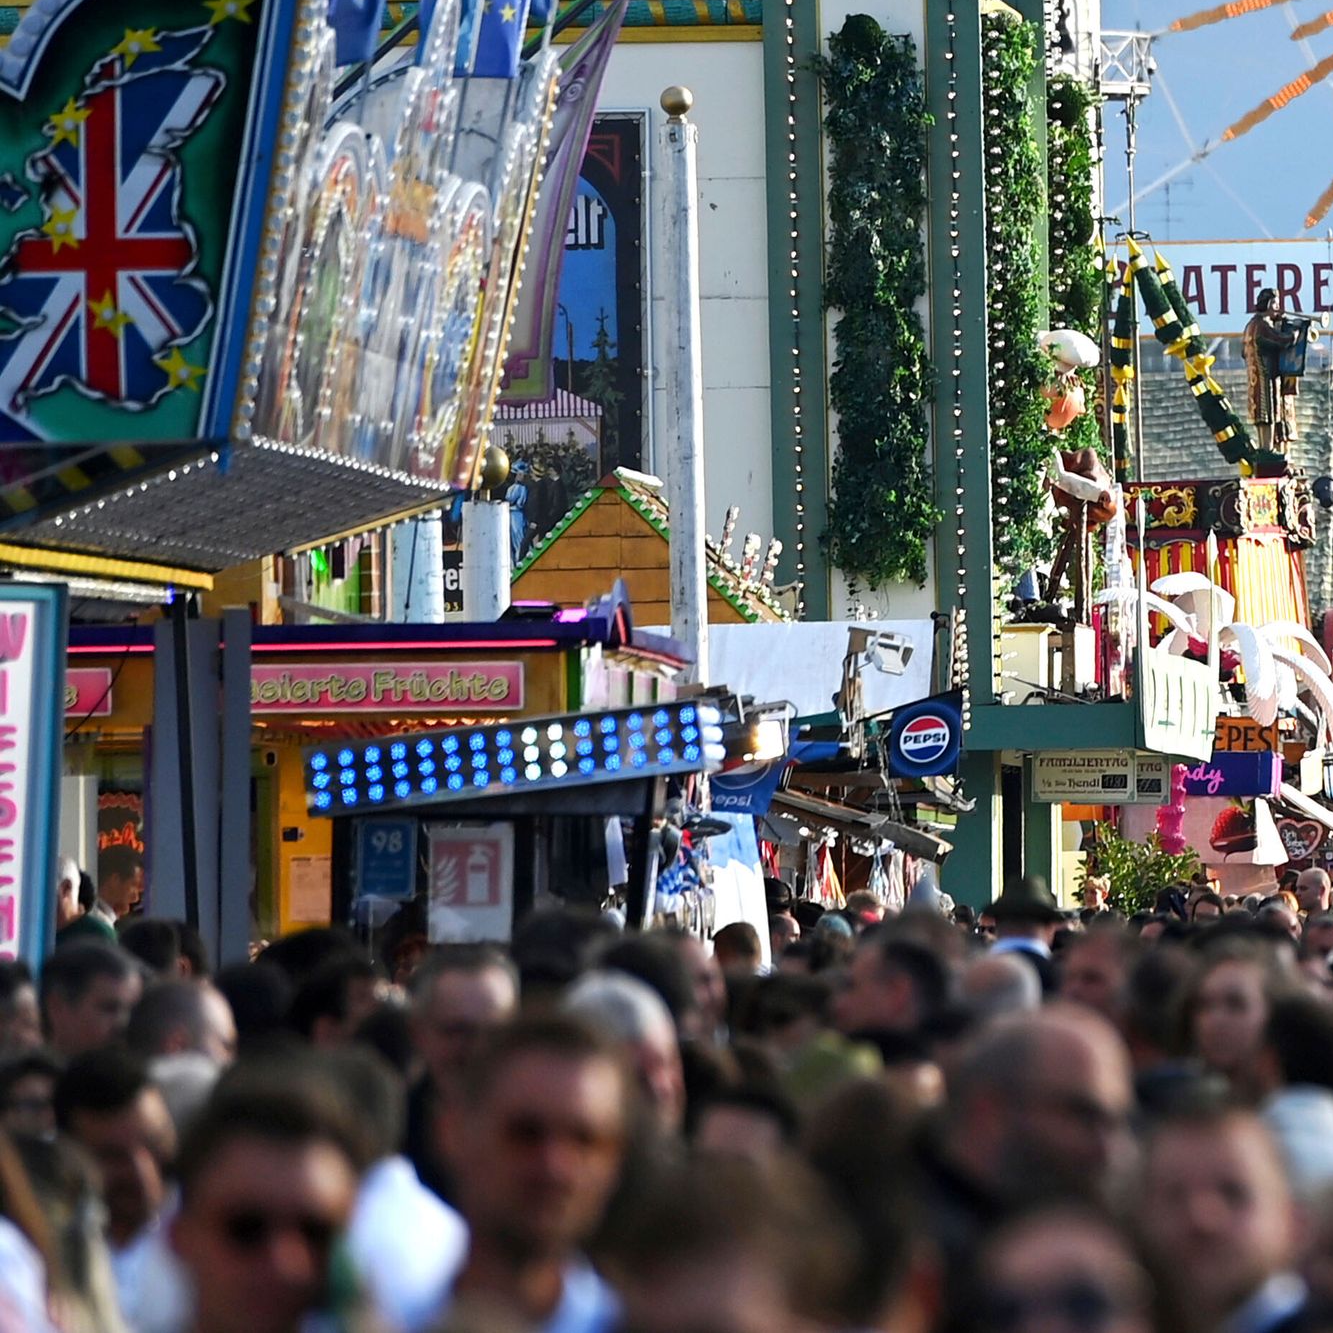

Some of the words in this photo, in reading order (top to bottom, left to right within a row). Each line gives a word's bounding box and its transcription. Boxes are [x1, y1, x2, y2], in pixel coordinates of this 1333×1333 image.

[372, 667, 510, 703] Früchte
[902, 734, 947, 745] PEPSI
[1067, 777, 1100, 789] Hendl
